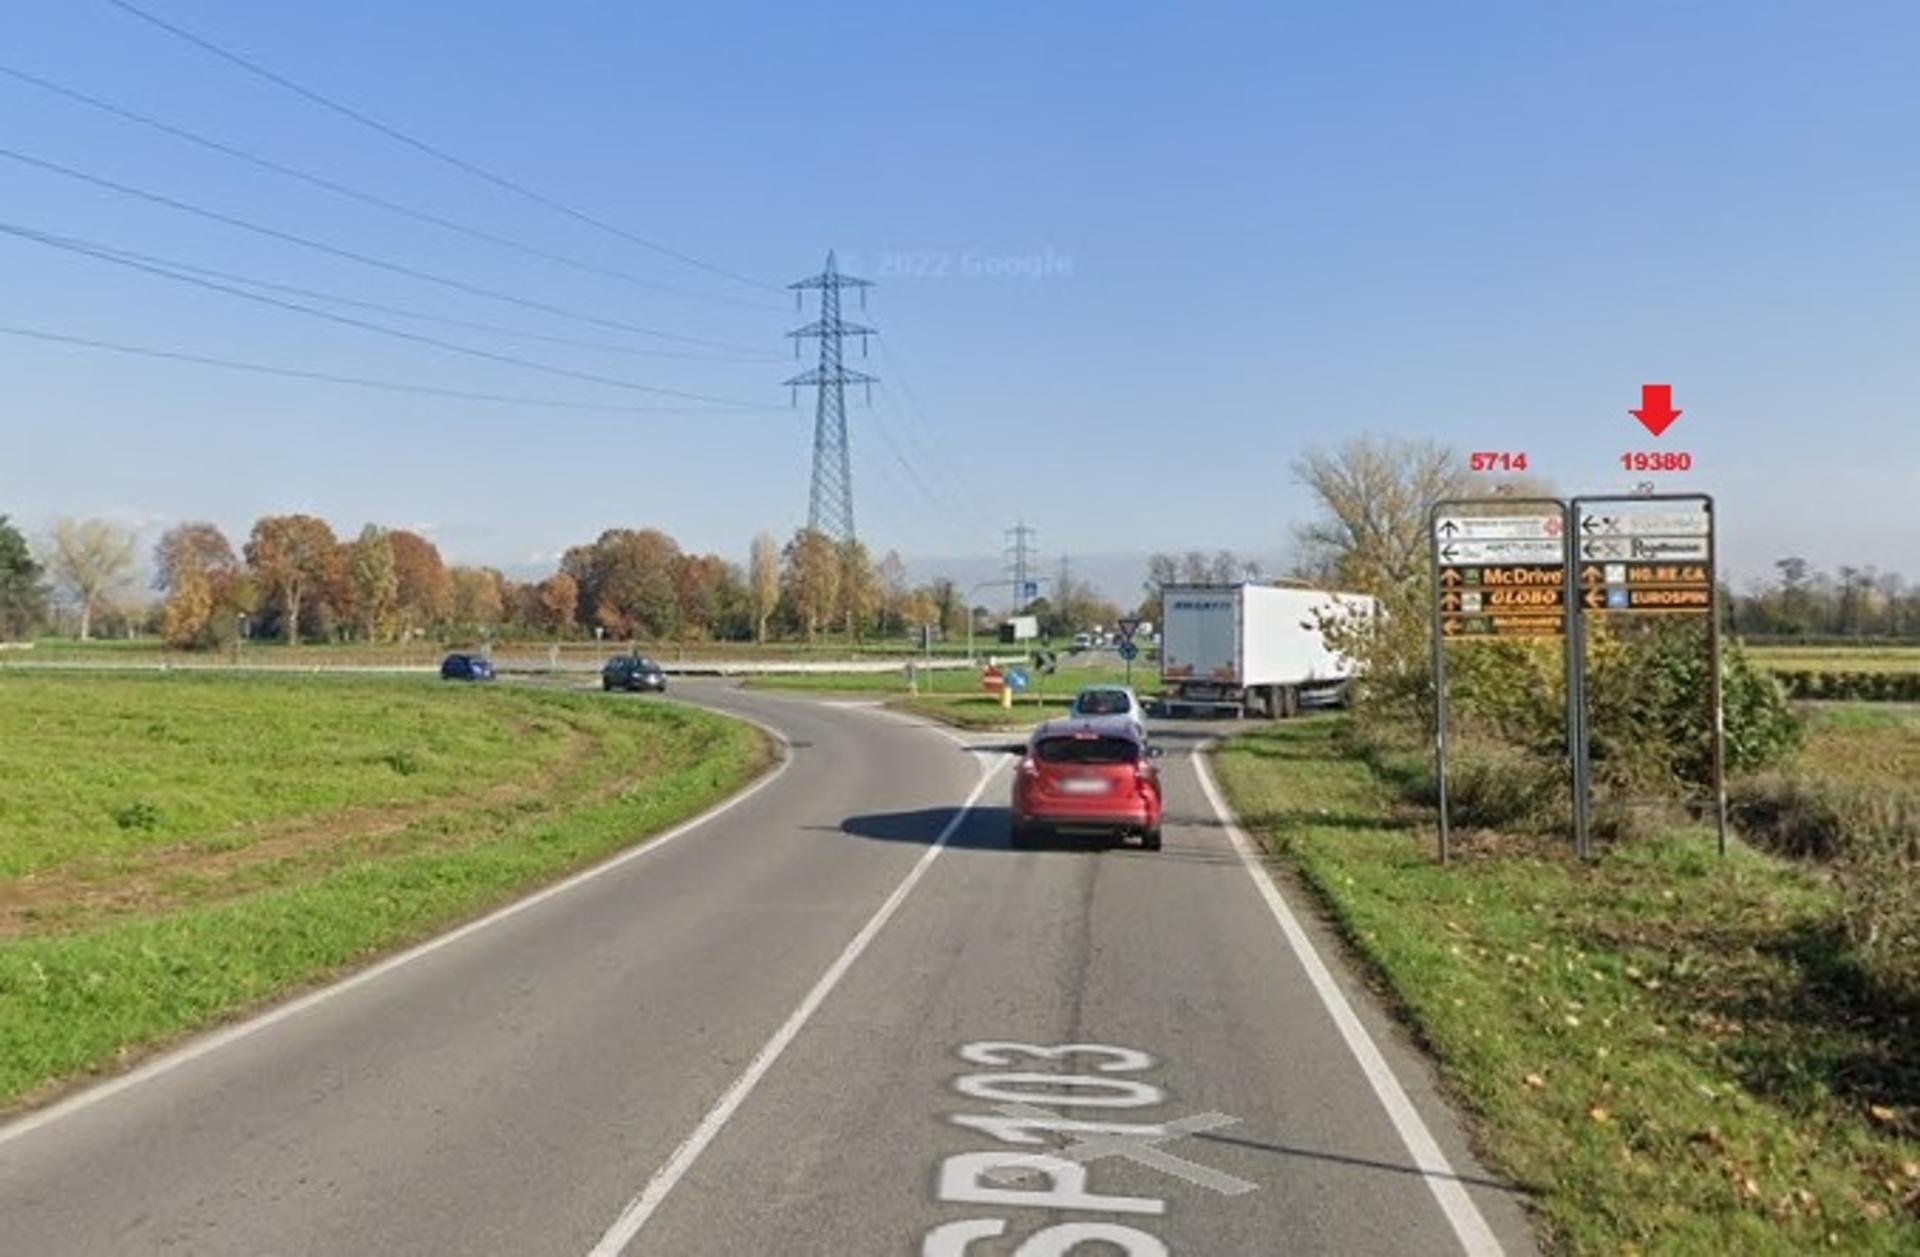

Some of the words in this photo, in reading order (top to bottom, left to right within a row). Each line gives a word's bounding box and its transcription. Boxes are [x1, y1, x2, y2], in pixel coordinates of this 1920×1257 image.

[1483, 568, 1562, 584] McDrive
[1491, 590, 1557, 604] GLOBO
[1631, 590, 1709, 604] EUROSPIN
